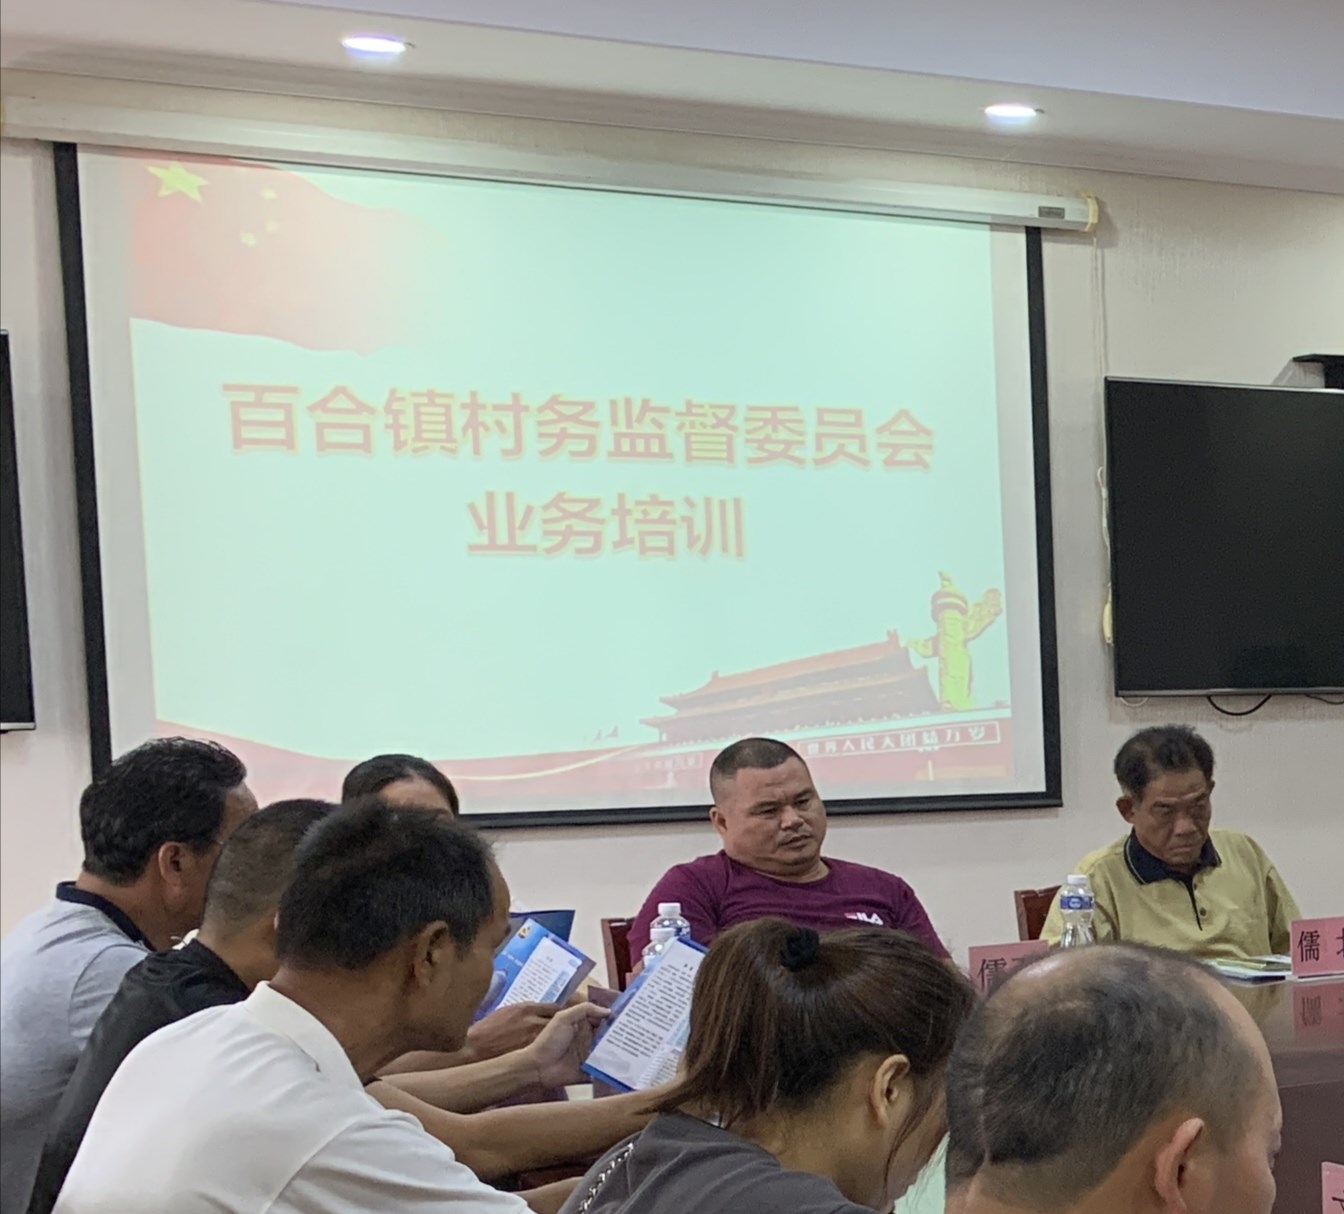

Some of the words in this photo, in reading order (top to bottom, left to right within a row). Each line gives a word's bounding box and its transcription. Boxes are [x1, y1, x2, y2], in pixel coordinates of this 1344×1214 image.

[222, 381, 936, 471] 百合镇村务监督委员会
[467, 489, 745, 560] 业务培训
